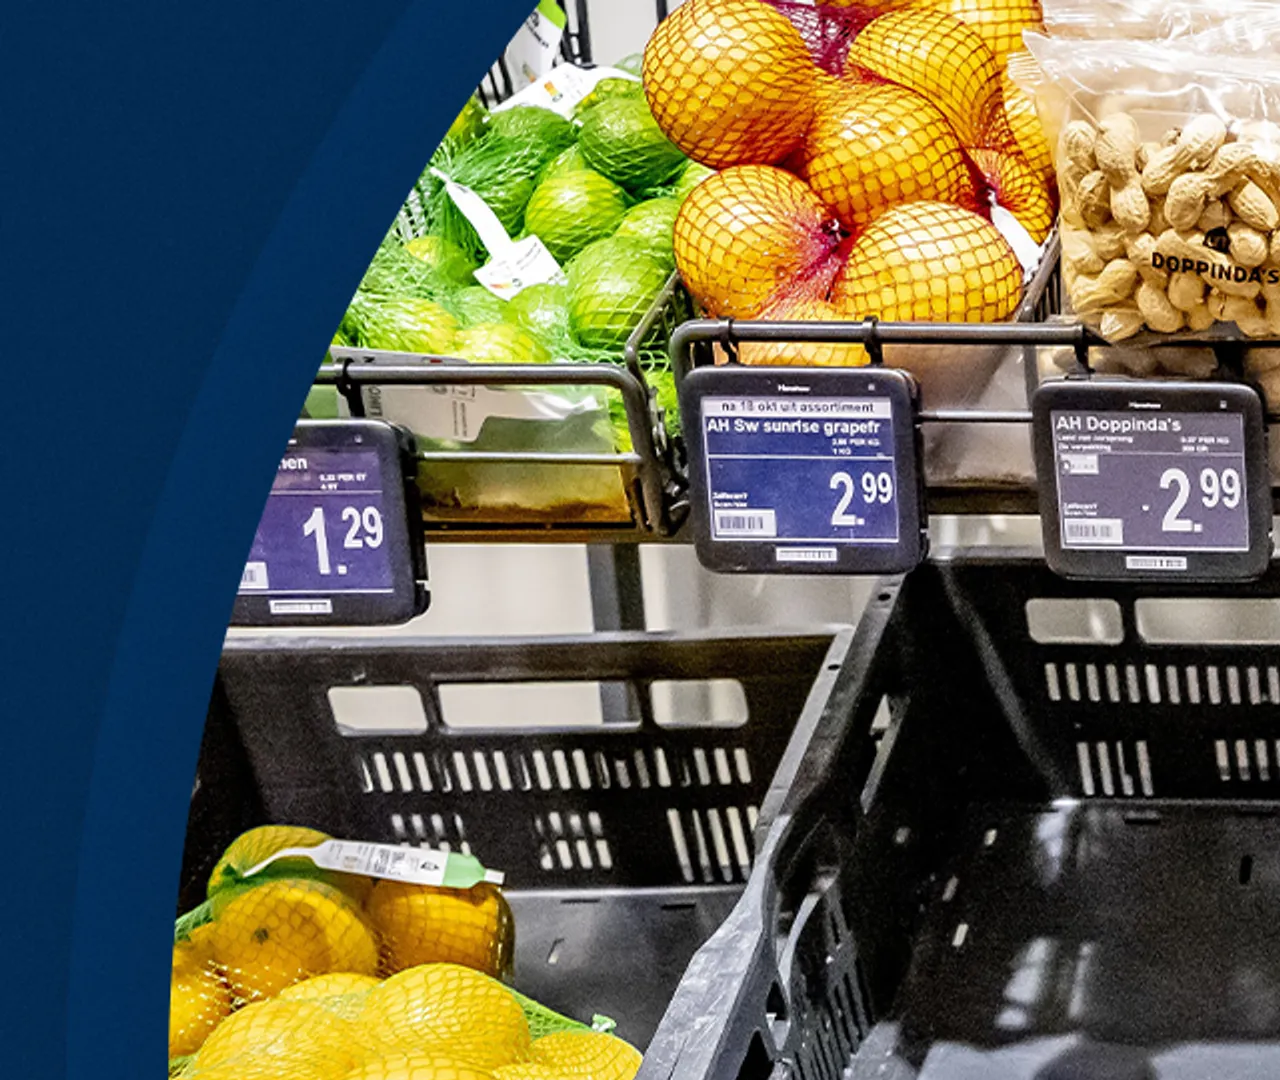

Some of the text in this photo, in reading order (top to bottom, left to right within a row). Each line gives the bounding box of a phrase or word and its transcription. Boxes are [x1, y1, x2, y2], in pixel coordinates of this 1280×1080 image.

[1152, 252, 1279, 283] DOPPINDA'S
[722, 403, 736, 411] na
[758, 402, 776, 411] okt
[781, 403, 795, 411] uit
[800, 403, 874, 412] assortiment
[707, 420, 880, 436] AH Sw sunrise grapefr
[1056, 417, 1182, 432] AH Doppinda's
